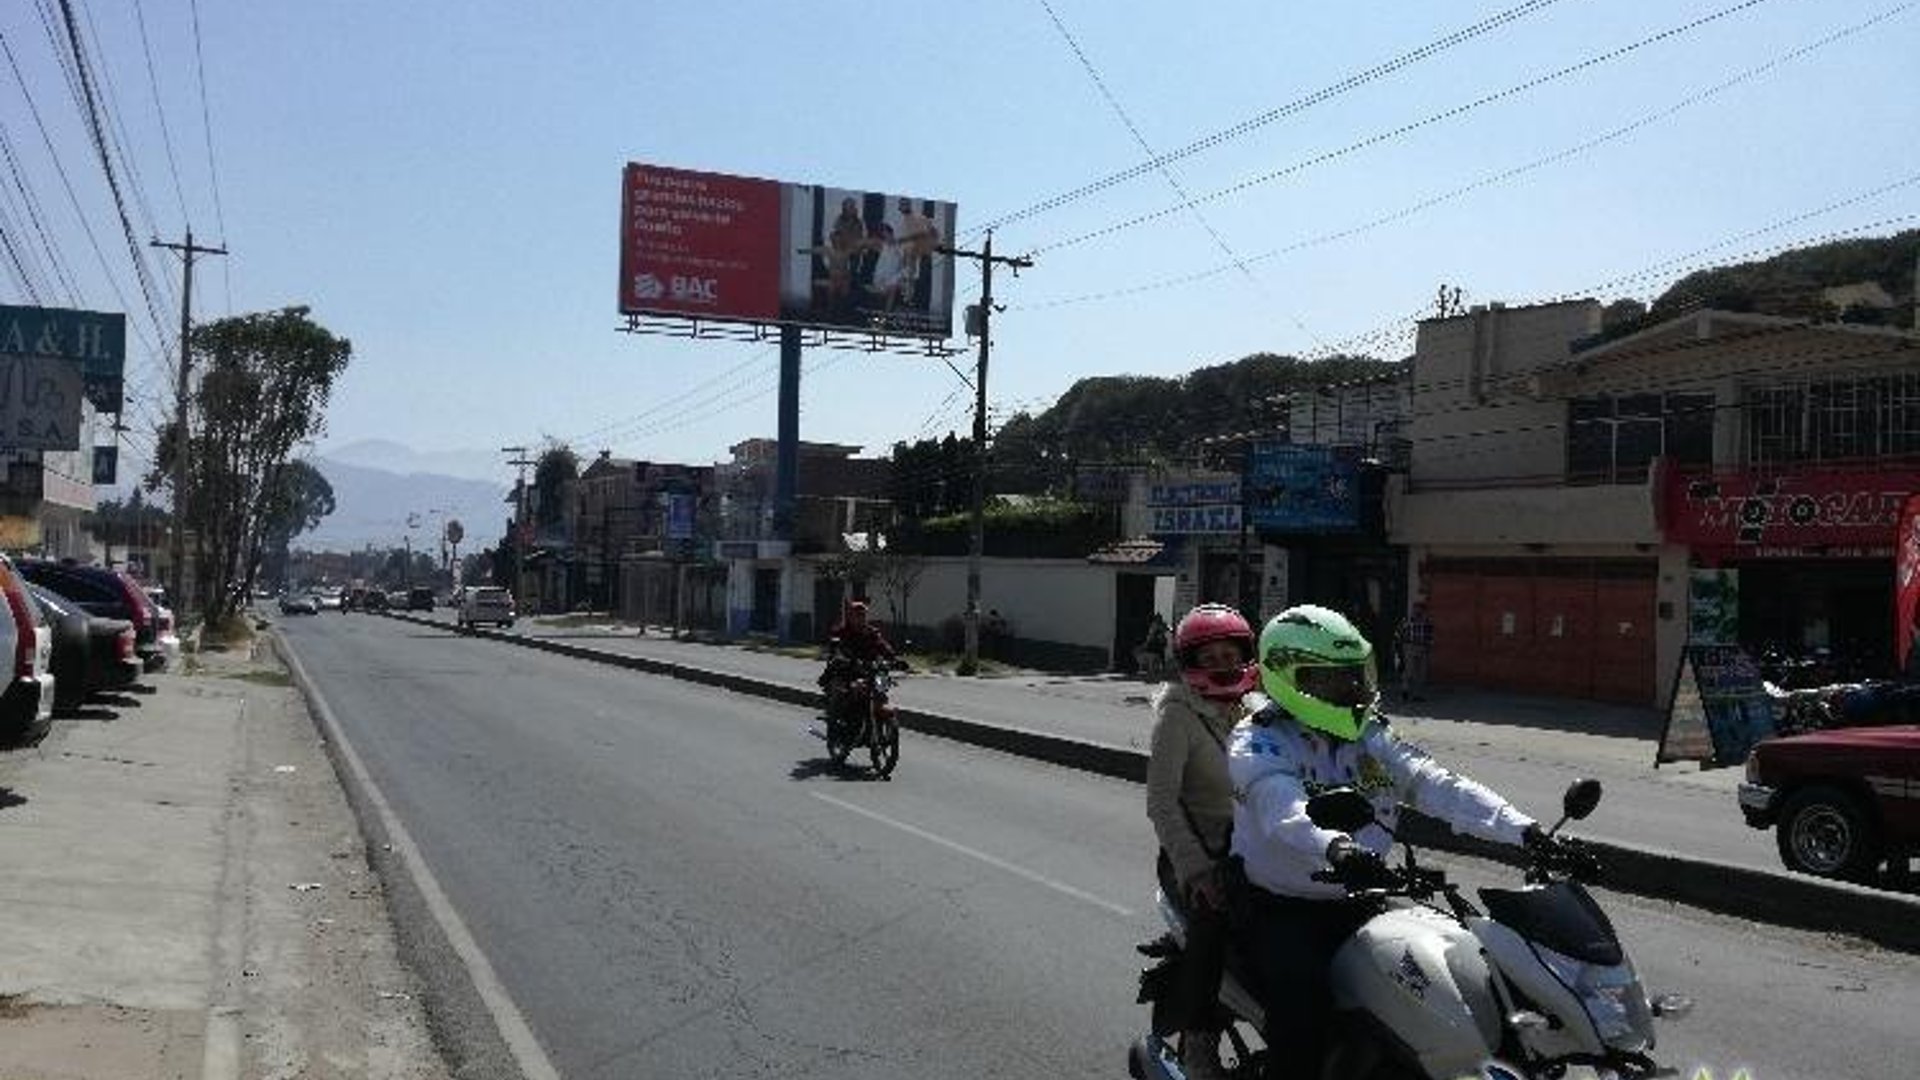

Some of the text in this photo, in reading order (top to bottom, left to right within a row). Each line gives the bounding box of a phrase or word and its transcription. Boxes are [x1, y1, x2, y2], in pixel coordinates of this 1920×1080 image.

[671, 276, 718, 300] BAC
[2, 319, 24, 352] A
[36, 321, 63, 355] &
[1153, 506, 1240, 531] ISRAEL
